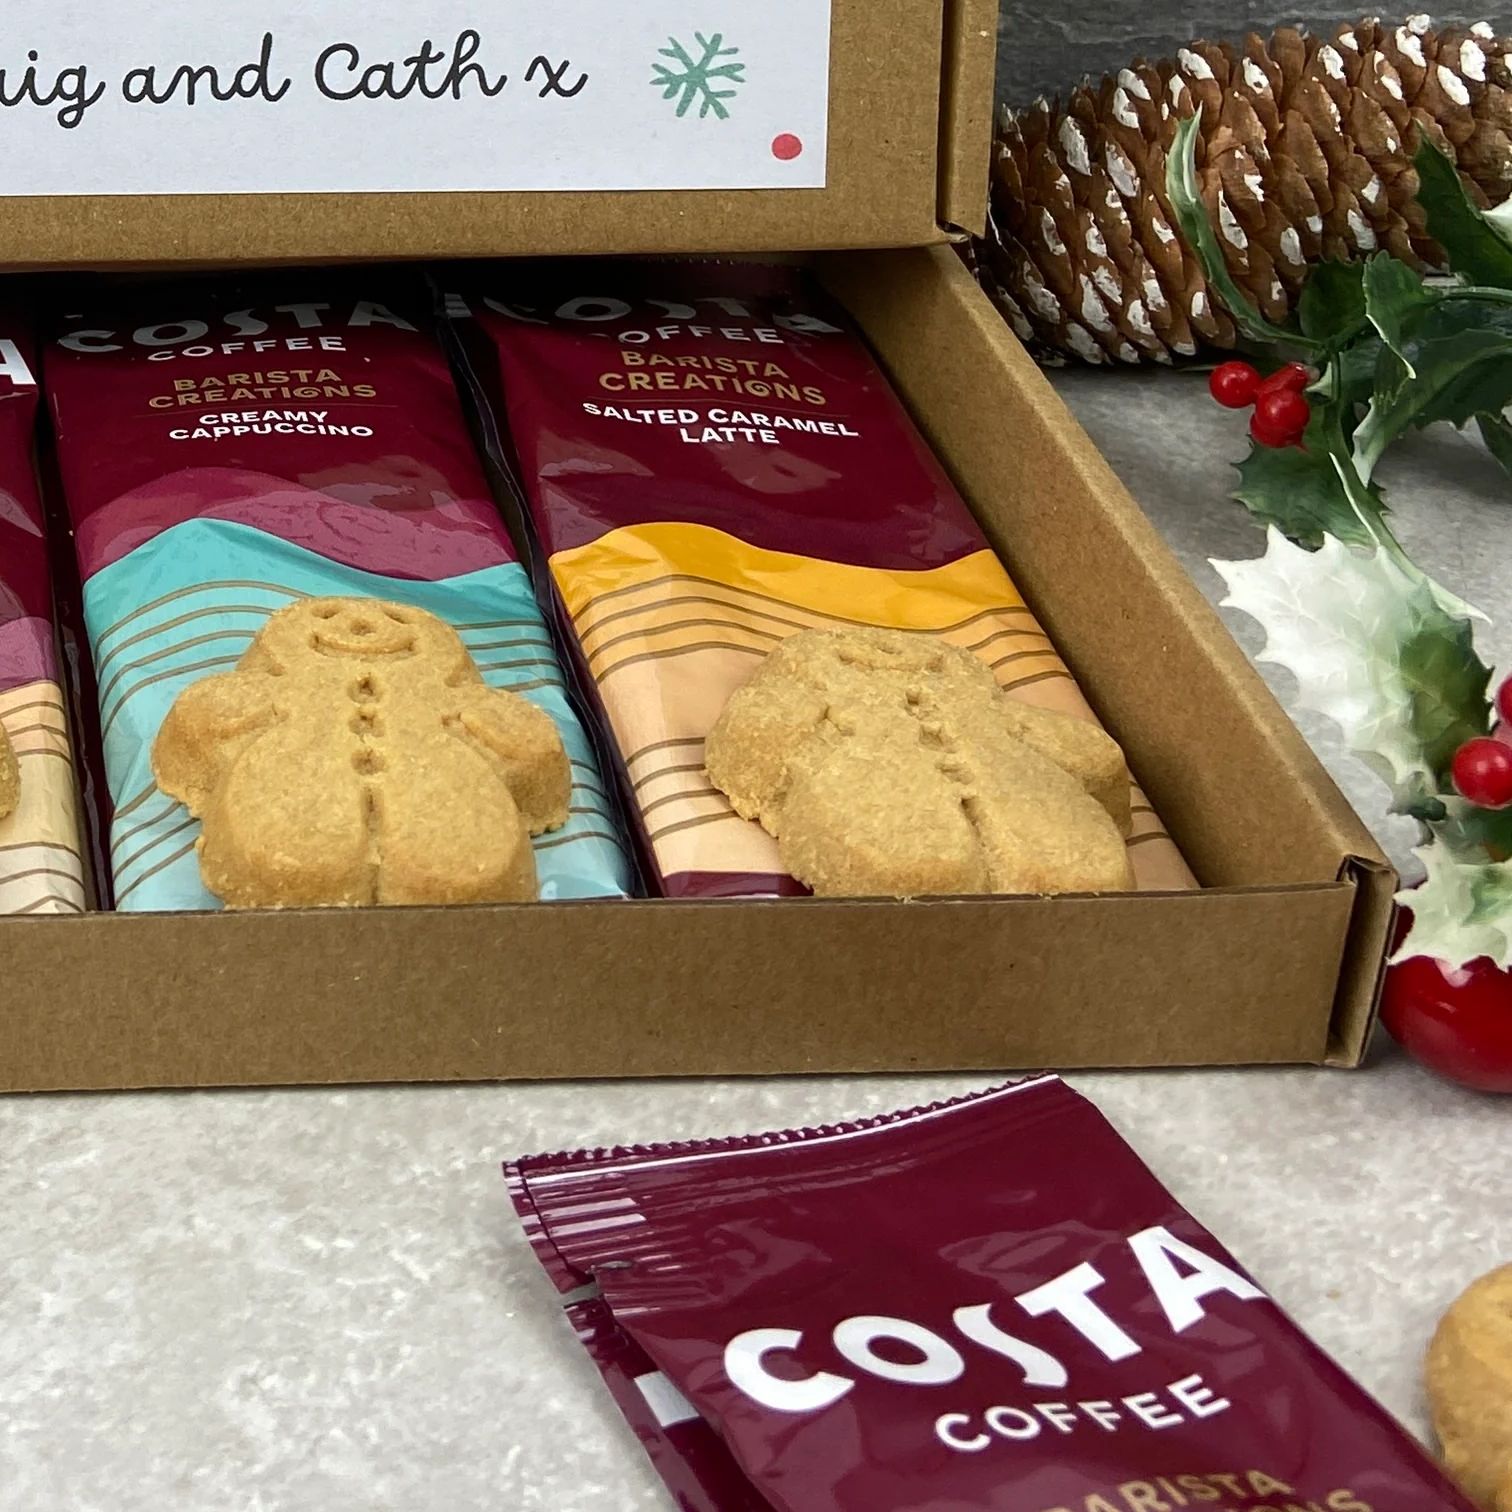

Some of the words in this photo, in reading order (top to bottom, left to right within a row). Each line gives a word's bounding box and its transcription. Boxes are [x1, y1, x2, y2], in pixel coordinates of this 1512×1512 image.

[121, 31, 292, 106] and
[314, 28, 508, 101] Cath
[523, 54, 589, 98] x
[57, 300, 420, 354] COSTA
[590, 324, 786, 345] OFFEE
[146, 335, 348, 362] COFFEE
[620, 349, 790, 380] BARISTA
[172, 368, 343, 393] BARISTA
[597, 371, 828, 407] CREATIONS
[147, 383, 378, 411] CREATIONS
[167, 422, 375, 441] CAPPUCCINO
[197, 409, 330, 426] CREAMY
[581, 401, 701, 425] SALTED
[706, 407, 861, 439] CARAMEL
[678, 425, 781, 445] LATTE
[723, 1224, 1268, 1414] COSTA
[934, 1373, 1232, 1453] COFFEE
[1040, 1470, 1296, 1512] ARISTA
